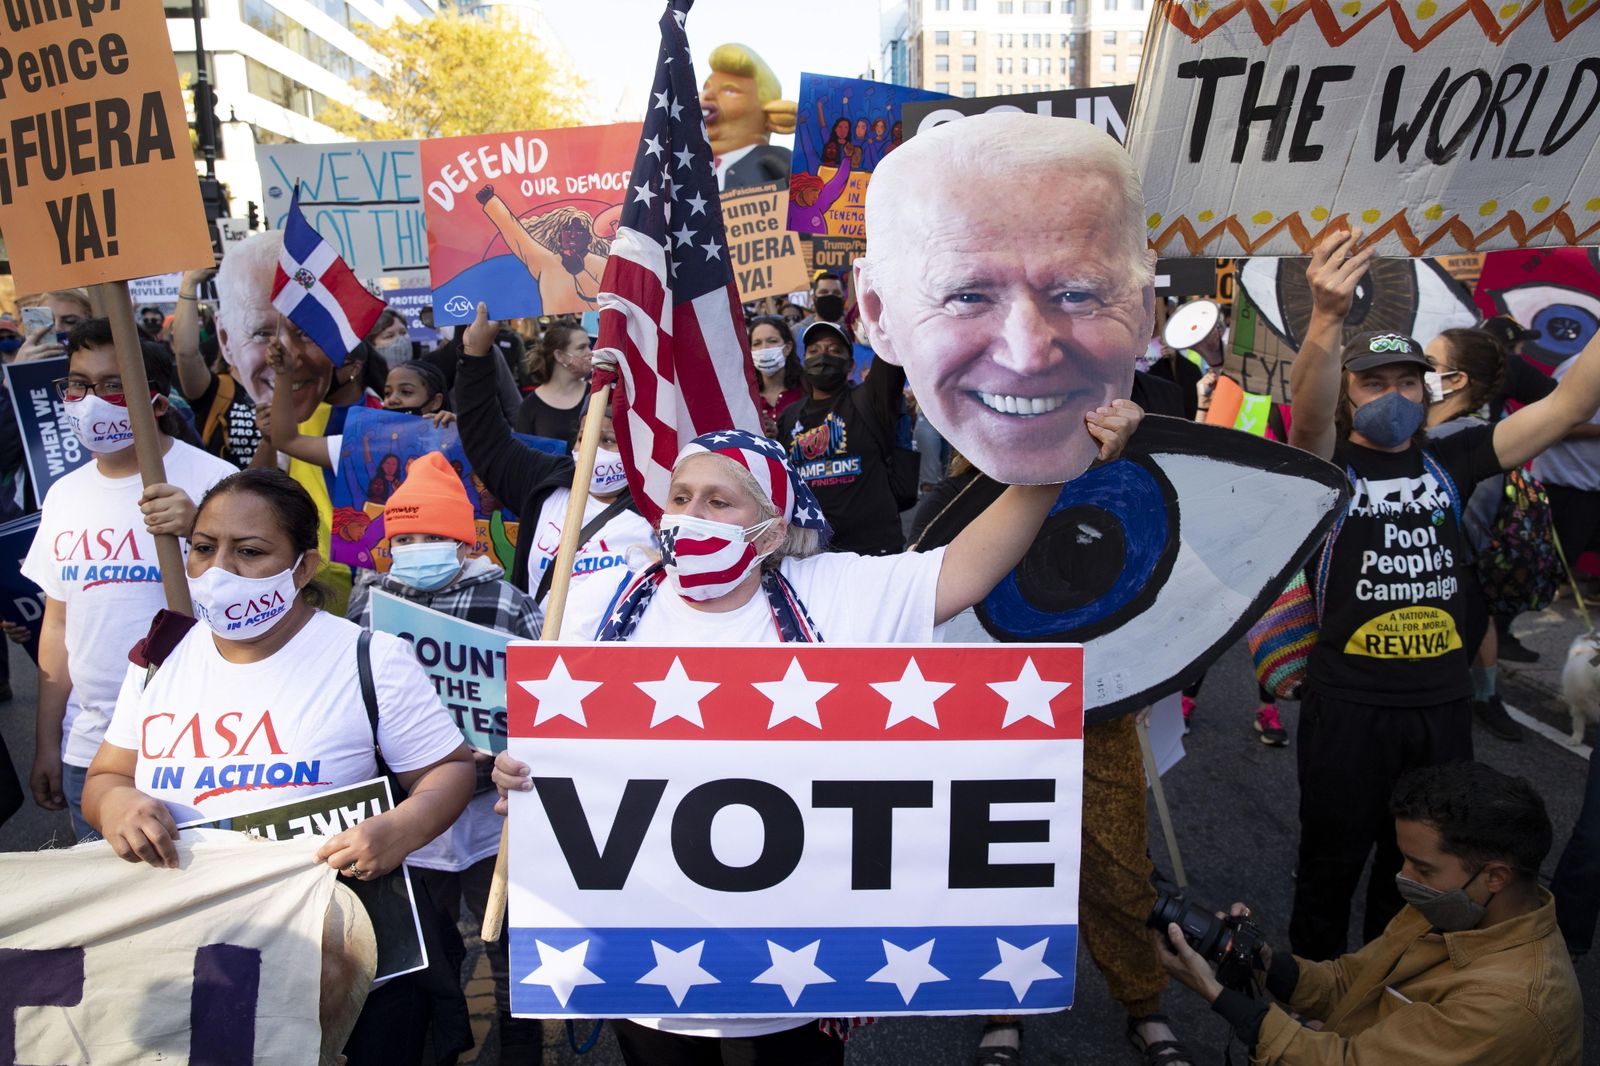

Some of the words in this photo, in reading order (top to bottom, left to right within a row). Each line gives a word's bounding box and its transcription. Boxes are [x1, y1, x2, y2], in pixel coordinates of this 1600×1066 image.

[1177, 56, 1357, 164] THE
[1373, 56, 1600, 166] WORLD
[269, 148, 421, 202] WE'VE
[427, 136, 549, 212] DEFEND
[520, 176, 560, 197] OUR
[722, 195, 778, 220] ump/
[829, 209, 865, 221] TENEMO
[46, 188, 119, 265] YA!
[277, 210, 356, 267] OT
[368, 209, 429, 266] THI
[816, 250, 845, 265] OUT
[131, 287, 178, 296] RIVILEGE
[738, 265, 773, 294] YA!
[444, 301, 474, 312] CASA
[30, 388, 52, 418] WE
[93, 419, 131, 434] CAS
[106, 432, 134, 440] ACTIO
[230, 428, 253, 437] PRO
[231, 420, 253, 428] PRO
[38, 421, 66, 477] WHEN
[595, 463, 624, 477] CAS
[54, 527, 144, 562] CASA
[61, 565, 78, 580] IN
[1360, 547, 1455, 579] People's
[1355, 574, 1458, 603] Campaign
[224, 590, 286, 621] CASA
[226, 621, 241, 631] IN
[244, 604, 285, 626] ACTION
[1399, 610, 1439, 621] NATIONAL
[1376, 623, 1400, 632] CALL
[1402, 623, 1419, 632] FOR
[429, 674, 482, 702] THE
[447, 702, 508, 737] TES
[141, 709, 289, 760] CASA
[151, 766, 185, 789] IN
[193, 759, 321, 789] ACTION
[531, 777, 1057, 893] VOTE
